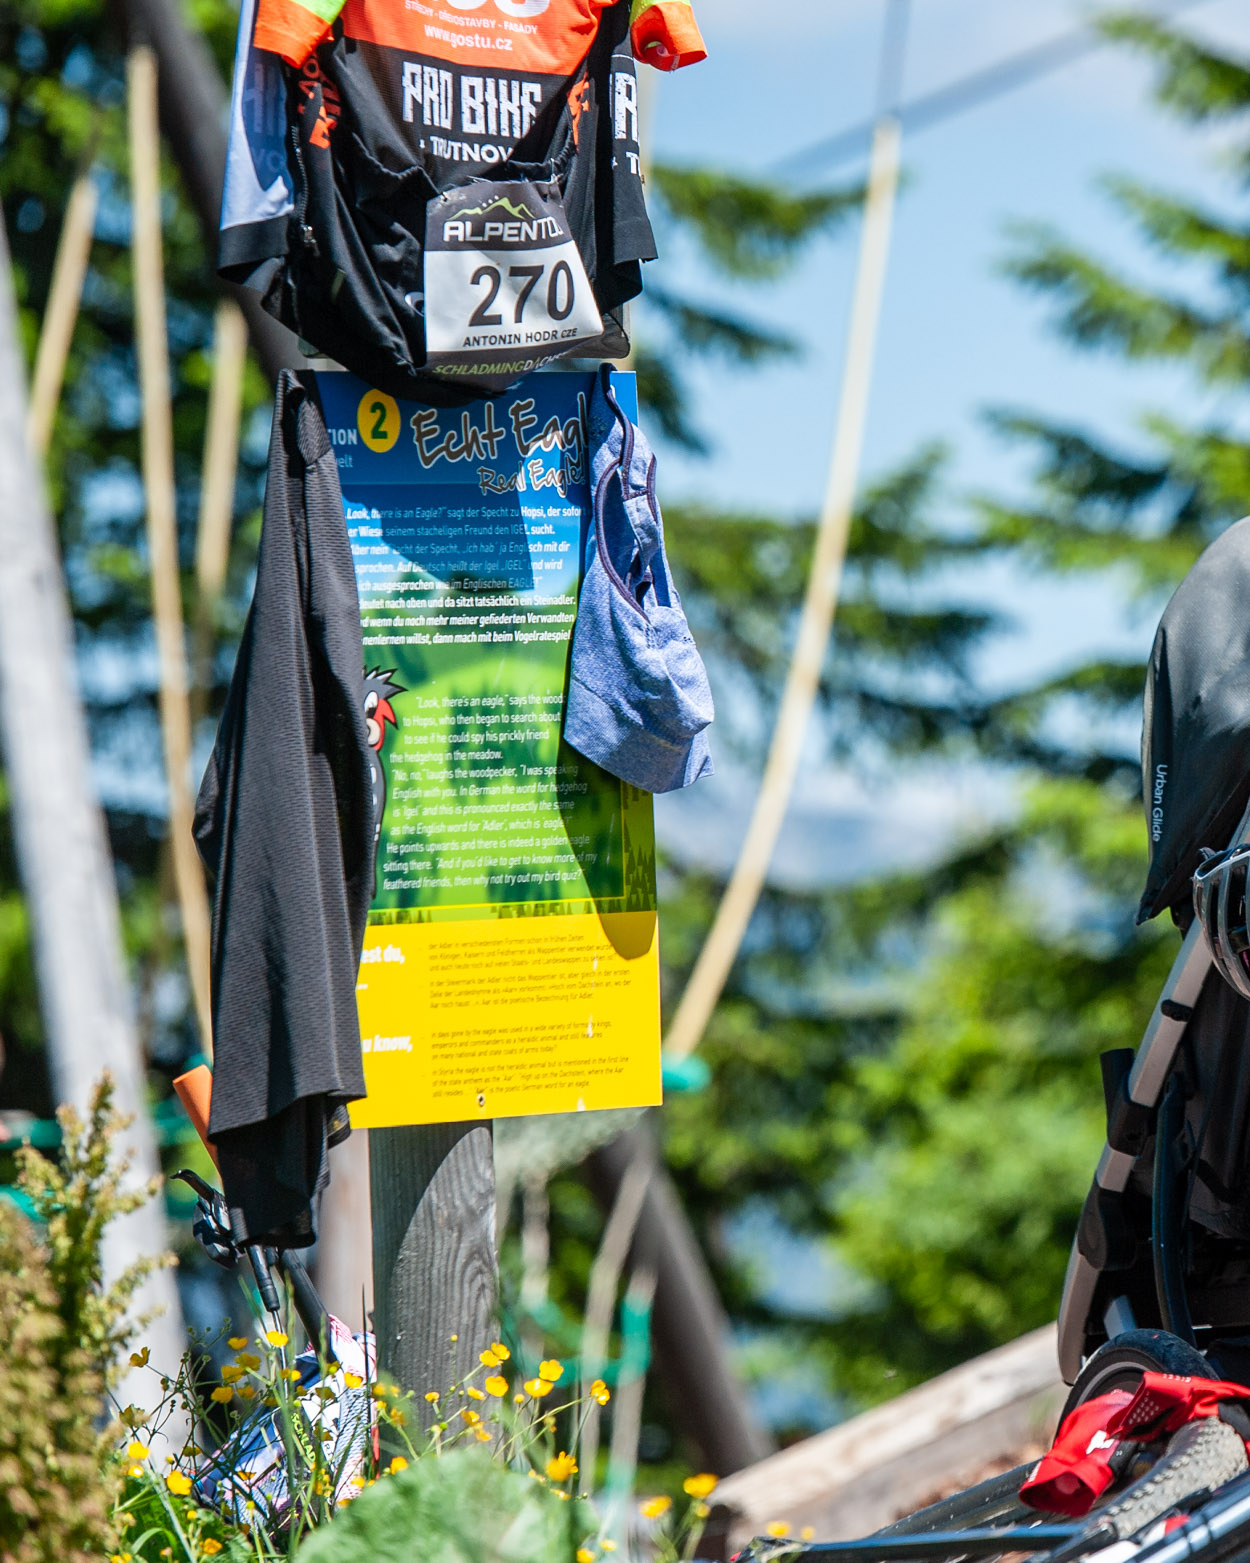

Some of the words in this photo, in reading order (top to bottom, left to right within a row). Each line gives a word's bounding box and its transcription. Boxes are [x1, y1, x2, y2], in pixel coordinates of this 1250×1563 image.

[402, 61, 454, 131] PRO
[468, 259, 575, 328] 270
[463, 333, 521, 348] ANTONIN
[525, 330, 558, 344] HODR
[560, 327, 578, 339] CZE
[369, 401, 388, 440] 2
[410, 402, 506, 470] Echt
[477, 460, 526, 496] Real
[448, 508, 464, 520] sagt
[466, 506, 480, 517] der
[482, 507, 508, 520] Specht
[522, 506, 546, 519] Hopsi,
[547, 506, 561, 516] der
[386, 526, 415, 536] seinem
[416, 525, 462, 538] stacheligen
[464, 524, 492, 535] Freund
[495, 524, 509, 535] den
[511, 524, 530, 535] IGEL
[531, 524, 556, 535] sucht.
[415, 544, 428, 554] der
[510, 541, 543, 554] Englisch
[544, 541, 557, 552] mit
[559, 541, 570, 552] dir
[397, 561, 412, 572] Auf
[412, 561, 445, 572] Deutsch
[448, 560, 467, 572] heißt
[467, 560, 482, 571] der
[484, 560, 499, 572] Igel
[544, 559, 563, 570] wird
[372, 580, 434, 593] ausgesprochen
[463, 578, 507, 592] Englischen
[385, 597, 405, 608] nach
[406, 597, 426, 608] oben
[428, 596, 444, 608] und
[445, 596, 456, 608] da
[456, 596, 474, 608] sitzt
[475, 595, 520, 607] tatsächlich
[520, 595, 532, 606] ein
[534, 594, 576, 606] Steinadler.
[370, 617, 392, 627] wenn
[393, 616, 404, 626] du
[405, 615, 425, 626] noch
[426, 614, 448, 626] mehr
[450, 614, 479, 625] meiner
[480, 613, 526, 628] gefiederten
[527, 612, 574, 624] Verwandten
[406, 632, 432, 645] willst,
[433, 632, 454, 644] dann
[454, 632, 477, 643] mach
[478, 630, 492, 642] mit
[493, 630, 514, 642] beim
[509, 696, 527, 707] says
[528, 694, 540, 704] the
[438, 714, 456, 724] who
[457, 714, 474, 724] then
[476, 713, 500, 726] began
[502, 714, 509, 723] to
[511, 712, 537, 722] search
[539, 711, 561, 722] about
[414, 736, 428, 744] see
[448, 732, 470, 742] could
[471, 732, 484, 744] spy
[486, 730, 498, 742] his
[499, 730, 526, 744] prickly
[526, 729, 549, 740] friend
[390, 752, 404, 763] the
[454, 750, 466, 760] the
[468, 749, 504, 760] meadow.
[455, 768, 468, 778] the
[468, 766, 518, 780] woodpecker,
[527, 767, 543, 776] was
[544, 765, 578, 778] speaking
[392, 787, 422, 802] English
[468, 784, 500, 796] German
[502, 784, 514, 794] the
[516, 782, 536, 794] word
[538, 782, 549, 792] for
[550, 781, 588, 794] hedgehog
[1154, 764, 1168, 804] Urban
[422, 806, 438, 816] and
[463, 802, 510, 816] pronounced
[510, 801, 538, 813] exactly
[540, 800, 552, 810] the
[553, 800, 574, 810] same
[402, 824, 416, 834] the
[416, 822, 446, 837] English
[447, 821, 468, 832] word
[509, 819, 532, 830] which
[534, 819, 540, 829] is
[1152, 807, 1164, 843] Glide
[386, 842, 398, 854] He
[400, 841, 424, 856] points
[426, 840, 459, 854] upwards
[461, 840, 476, 850] and
[477, 838, 498, 850] there
[500, 838, 506, 848] is
[508, 836, 534, 848] indeed
[542, 836, 568, 848] golden
[570, 834, 590, 848] eagle
[383, 860, 409, 874] sitting
[484, 856, 498, 867] like
[500, 856, 508, 866] to
[508, 856, 522, 868] get
[523, 855, 530, 864] to
[532, 853, 552, 864] know
[554, 854, 575, 862] more
[576, 850, 584, 860] of
[586, 853, 598, 864] my
[383, 876, 422, 890] feathered
[454, 876, 472, 886] then
[473, 874, 490, 888] why
[490, 874, 504, 884] not
[504, 874, 516, 886] try
[517, 872, 530, 883] out
[531, 874, 544, 884] my
[544, 870, 560, 882] bird
[383, 943, 406, 965] du,
[373, 1033, 413, 1053] know,
